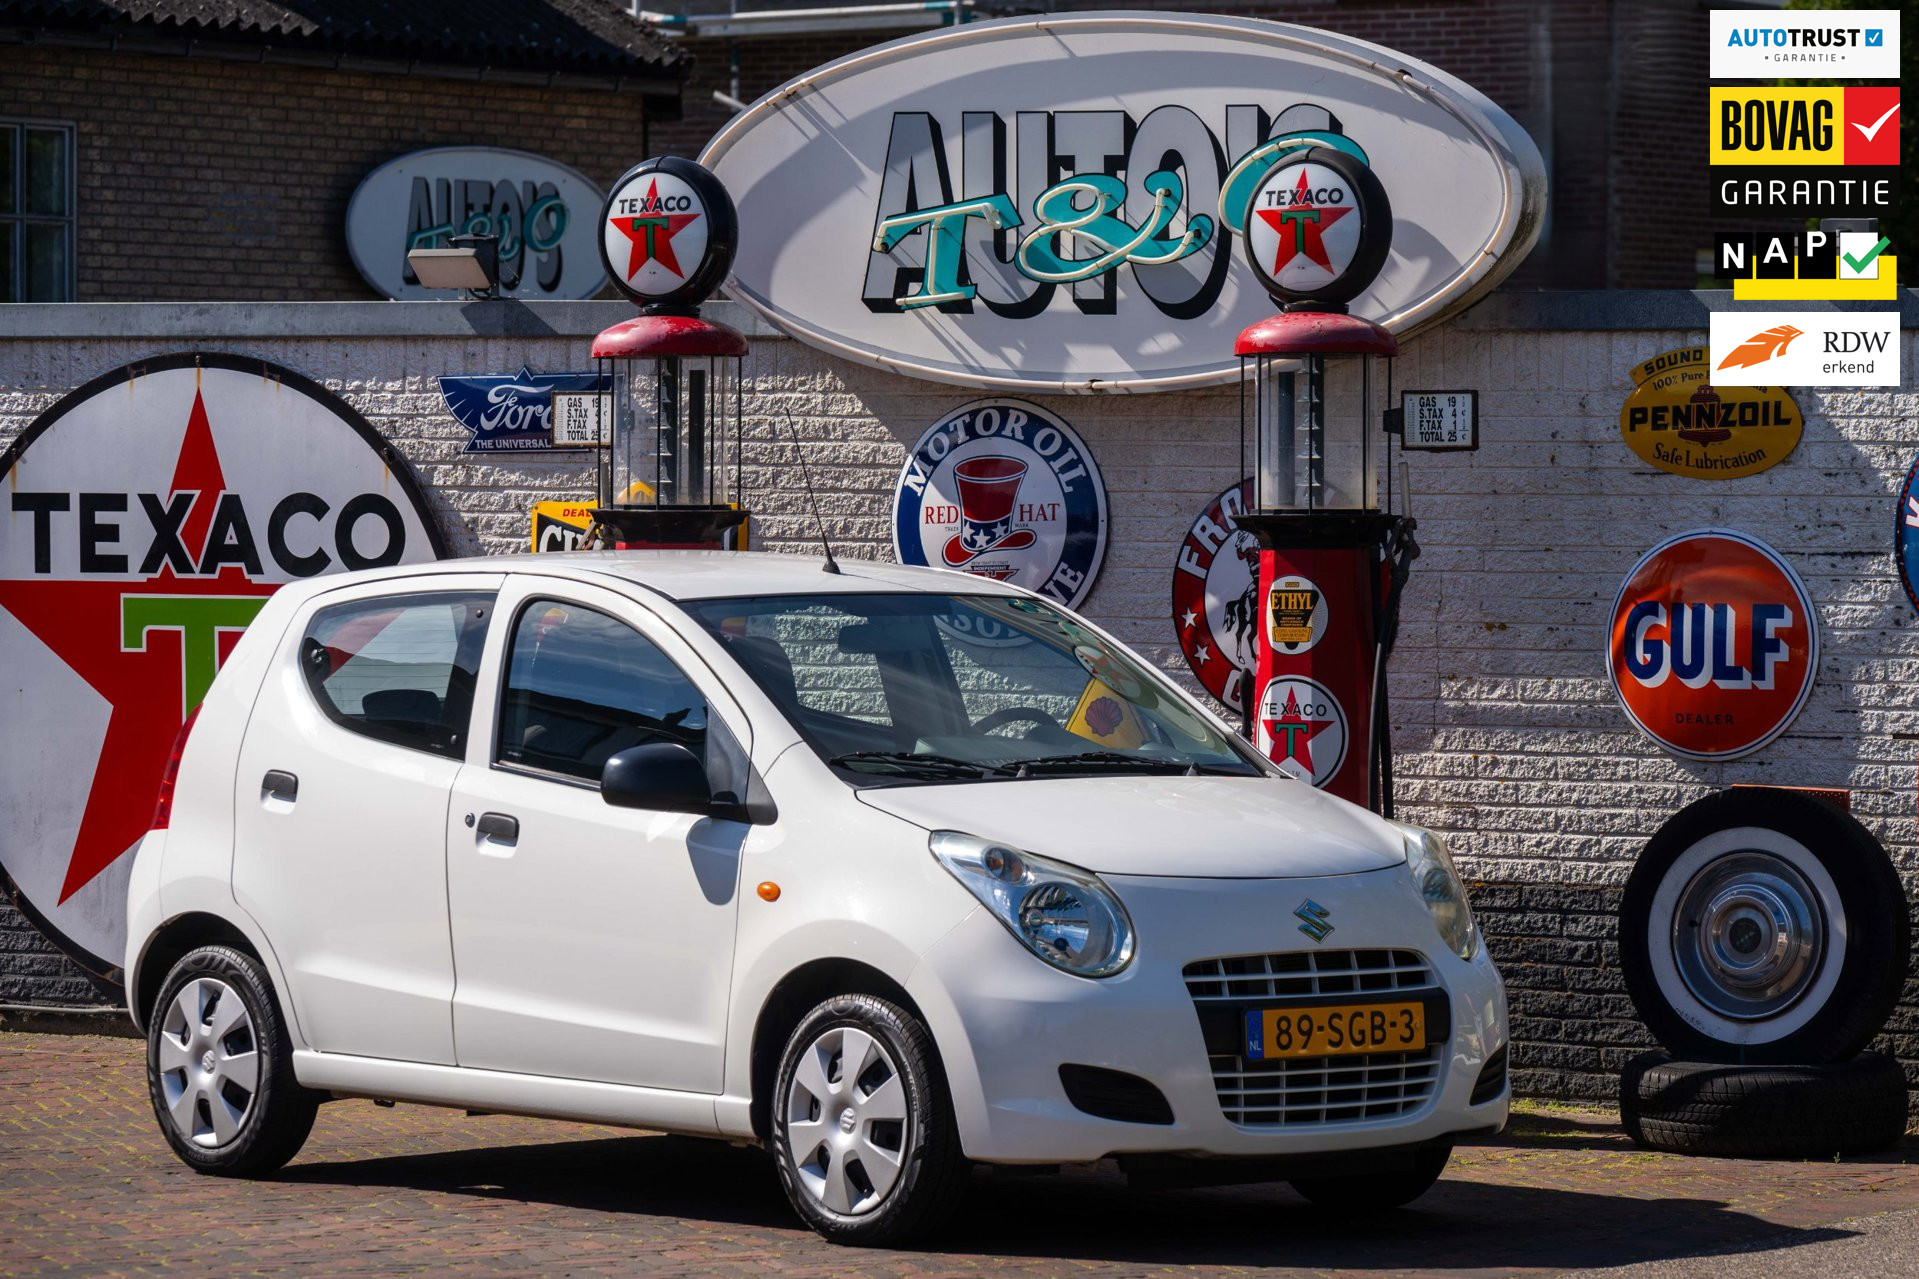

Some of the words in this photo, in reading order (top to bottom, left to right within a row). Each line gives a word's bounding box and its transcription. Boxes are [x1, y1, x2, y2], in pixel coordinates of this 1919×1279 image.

[618, 195, 692, 214] TEXACO
[1265, 187, 1344, 207] TEXACO
[1643, 349, 1703, 376] SOUND
[1652, 377, 1678, 391] 100%
[1681, 371, 1704, 383] Pure
[567, 397, 583, 408] GAS
[1419, 396, 1437, 408] GAS
[1447, 396, 1457, 408] 19
[567, 408, 588, 419] S.TAX
[1419, 408, 1444, 419] S.TAX
[1451, 408, 1457, 419] 4
[1628, 400, 1792, 432] PENNZOIL
[567, 419, 587, 430] F.TAX
[1419, 420, 1443, 431] F.TAX
[1452, 420, 1457, 431] 1
[475, 440, 494, 449] THE
[496, 438, 552, 449] UNIVERSAL
[567, 430, 588, 441] TOTAL
[1419, 431, 1445, 442] TOTAL
[1447, 431, 1457, 442] 25
[904, 408, 1028, 497] MOTOR
[1033, 427, 1087, 494] OIL
[1652, 442, 1683, 466] Safe
[1685, 448, 1767, 470] Lubrication
[924, 504, 959, 525] RED
[1019, 503, 1061, 522] HAT
[11, 492, 406, 577] TEXACO
[1271, 592, 1314, 610] ETHYL
[1623, 601, 1794, 690] GULF
[1264, 702, 1327, 716] TEXACO
[1675, 712, 1734, 726] DEALER
[1275, 1008, 1415, 1051] 89-SGB-3
[1249, 1040, 1262, 1051] NL
